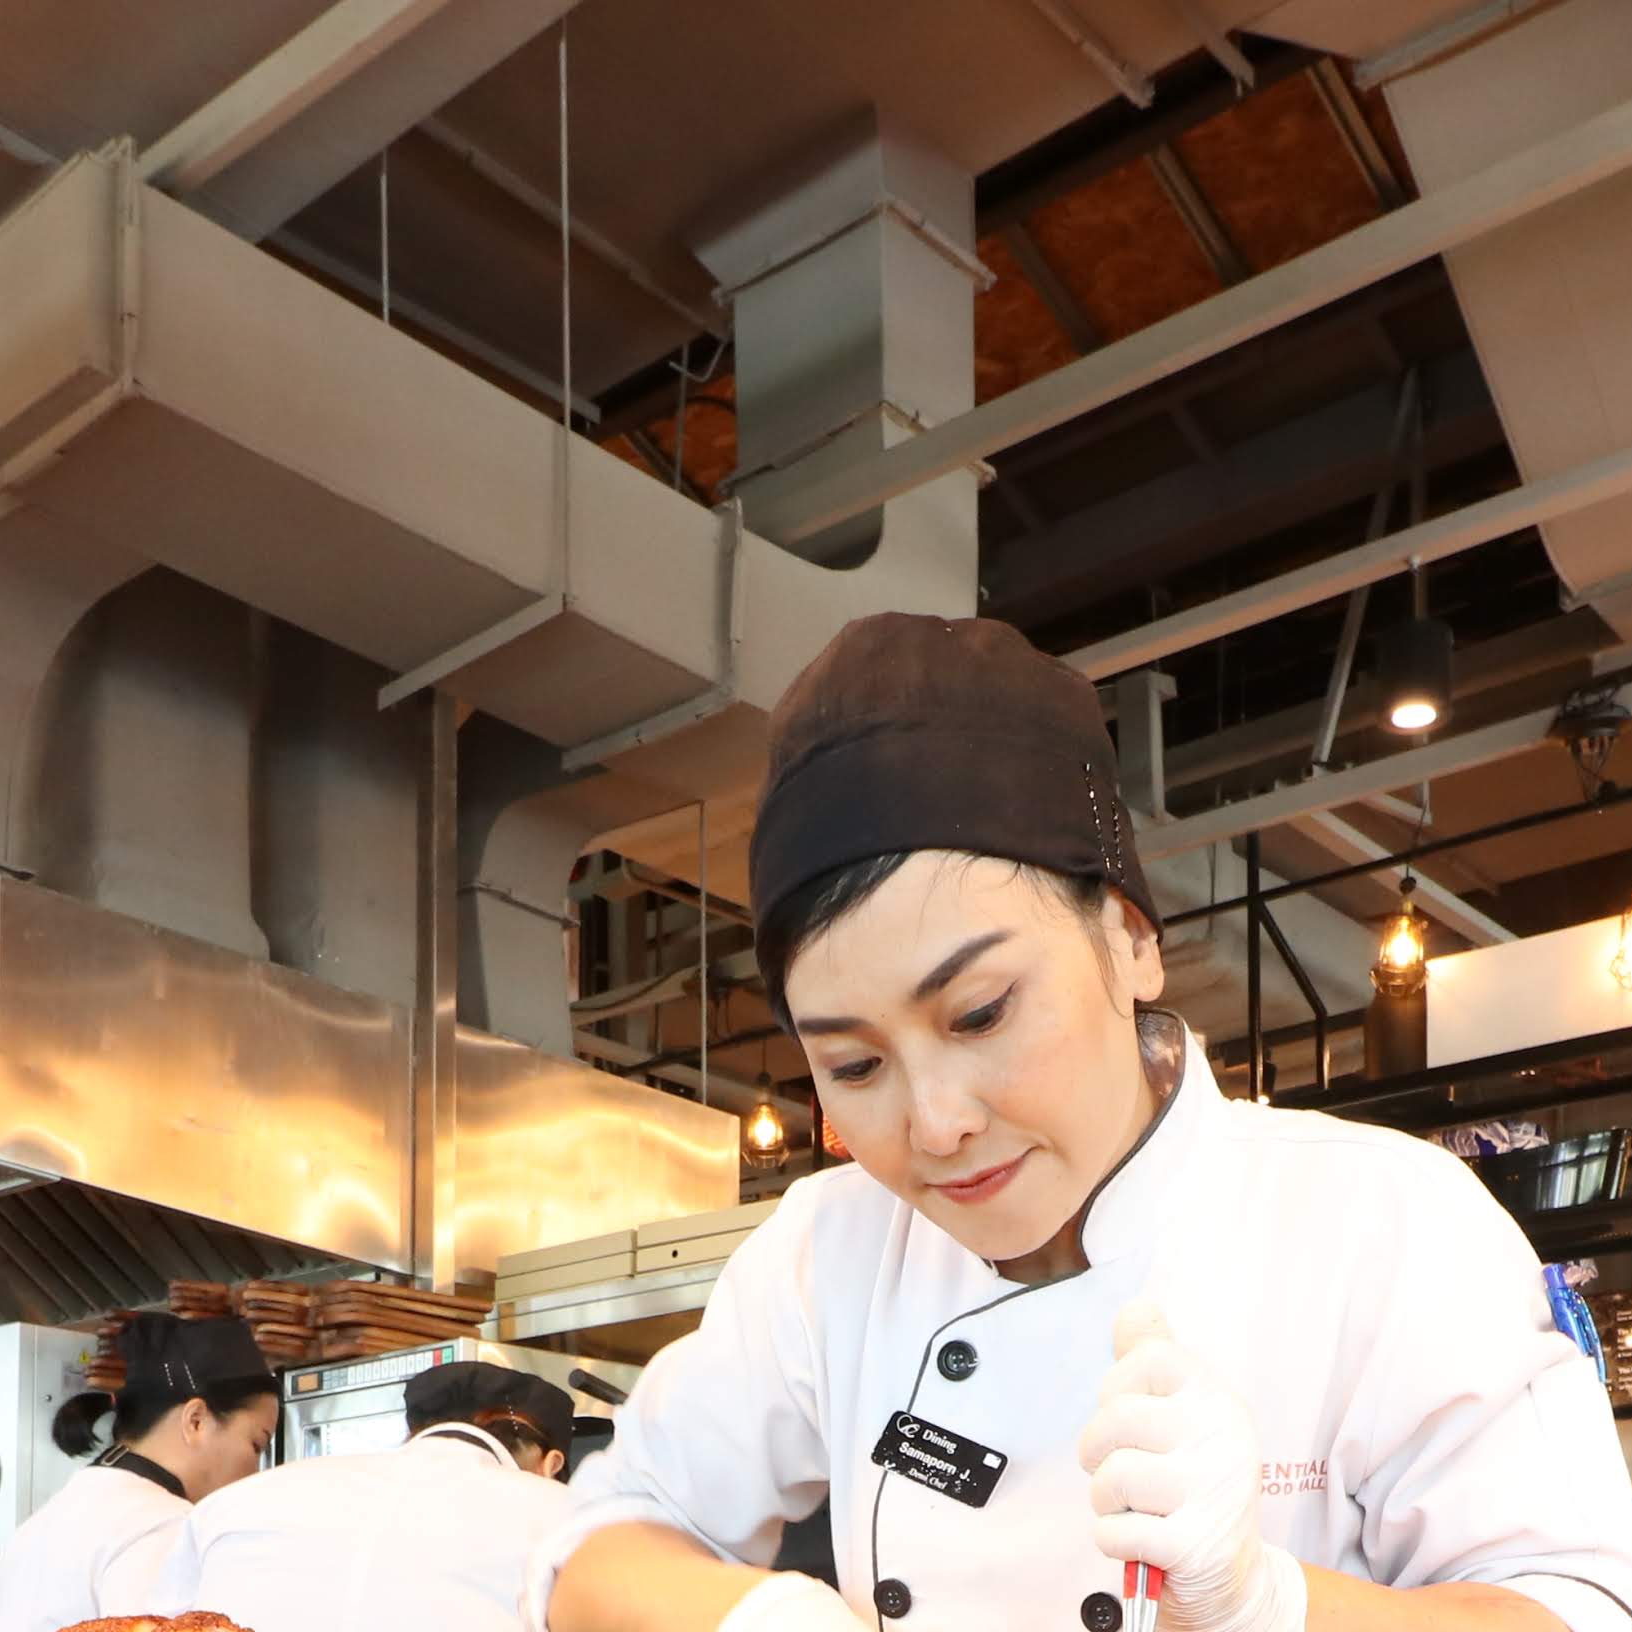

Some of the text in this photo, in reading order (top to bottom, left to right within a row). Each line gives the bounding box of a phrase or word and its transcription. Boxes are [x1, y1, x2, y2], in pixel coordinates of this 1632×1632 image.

[922, 1429, 958, 1455] Dining
[898, 1441, 957, 1475] Samaporn
[929, 1474, 948, 1490] Chef
